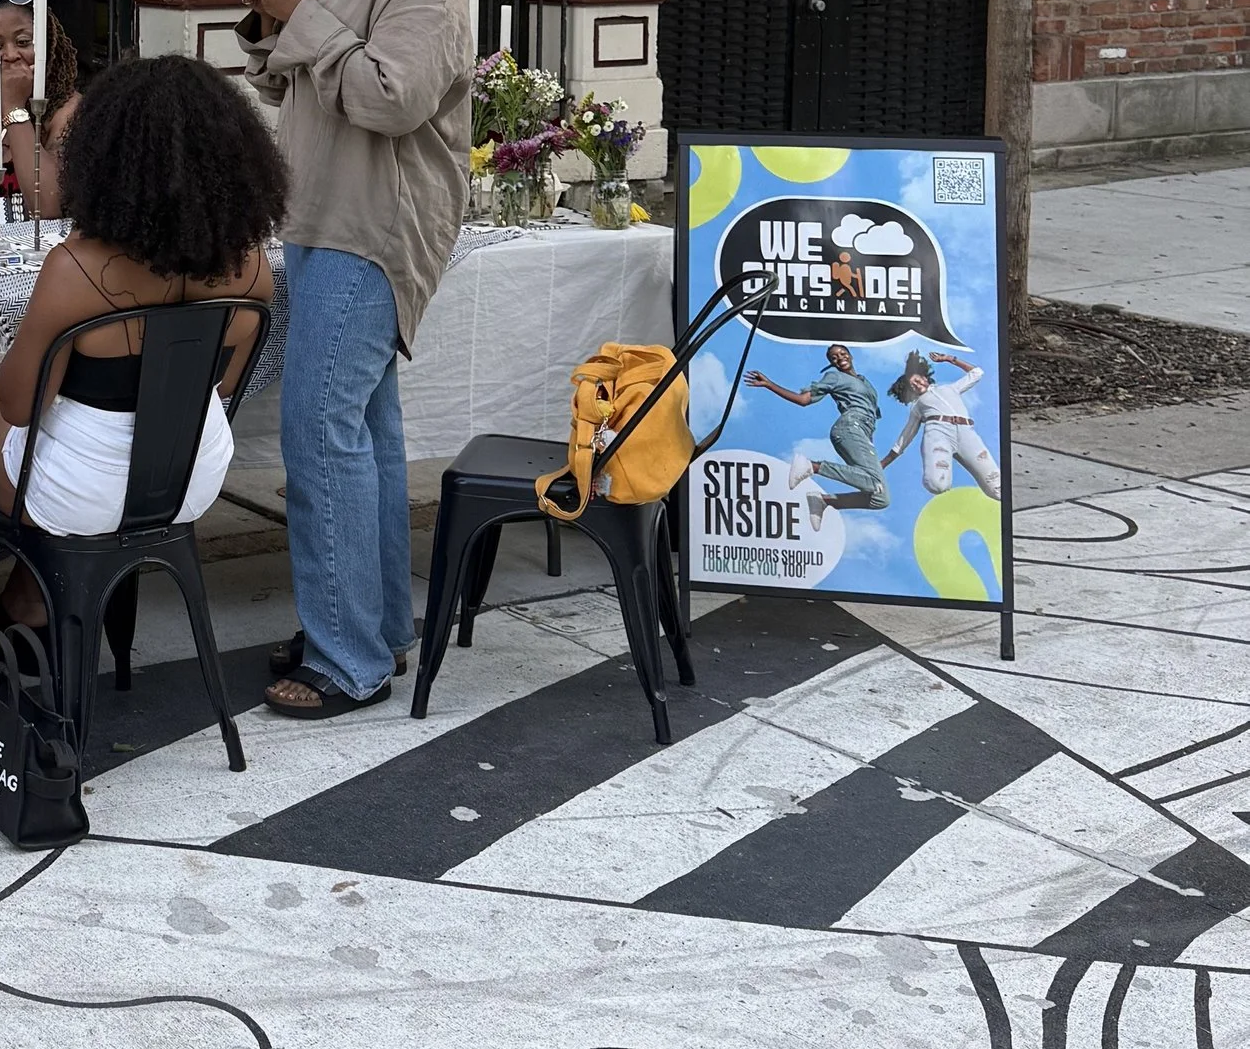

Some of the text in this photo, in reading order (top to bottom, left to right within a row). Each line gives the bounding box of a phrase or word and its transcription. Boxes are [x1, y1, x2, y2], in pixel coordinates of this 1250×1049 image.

[759, 220, 823, 262] WE
[743, 296, 921, 315] NCINNATI
[703, 460, 770, 500] STEP
[704, 497, 801, 541] INSIDE
[702, 544, 823, 566] THE OUTDOORS SHOULD
[703, 557, 730, 573] LOOK
[732, 559, 754, 575] LIKE
[783, 561, 806, 578] TOO!
